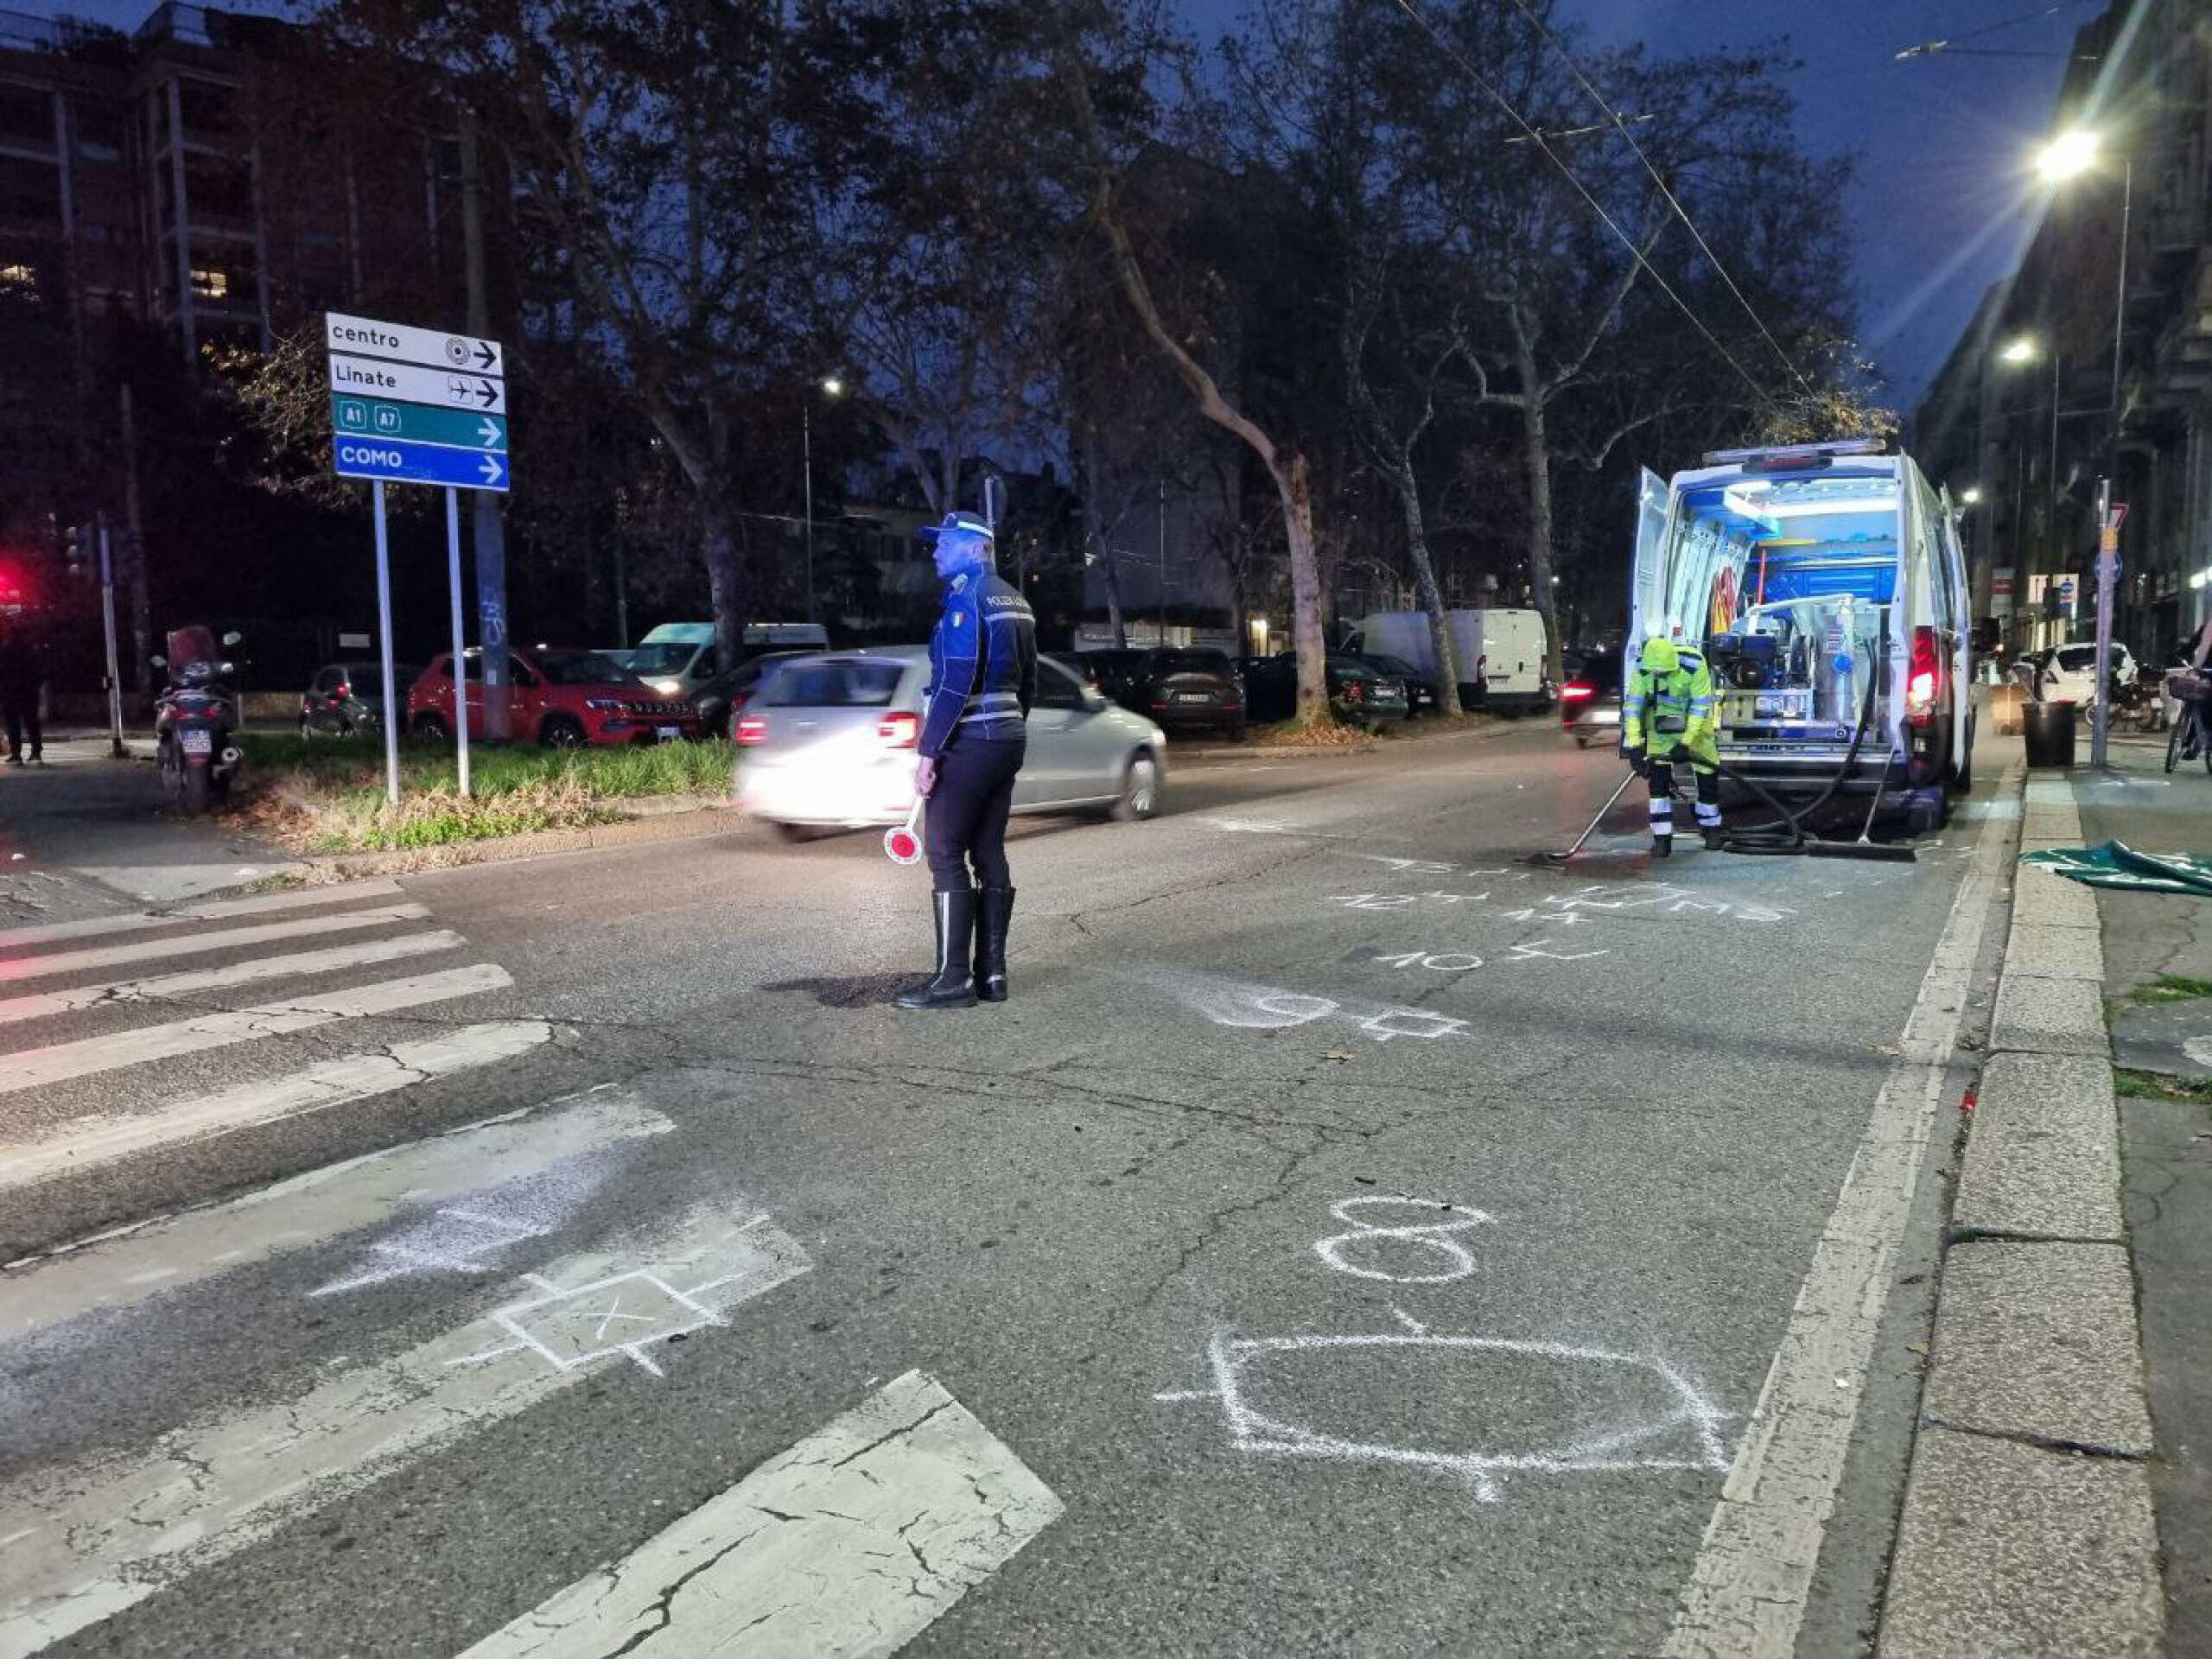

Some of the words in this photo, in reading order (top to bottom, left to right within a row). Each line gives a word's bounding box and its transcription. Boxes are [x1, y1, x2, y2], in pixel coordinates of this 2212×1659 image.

[333, 325, 400, 348] centro
[335, 364, 397, 388] Linate
[345, 406, 361, 423] A1
[379, 410, 396, 427] A7
[340, 445, 403, 467] COMO
[1372, 950, 1484, 970] 10
[1315, 1195, 1497, 1284] 8
